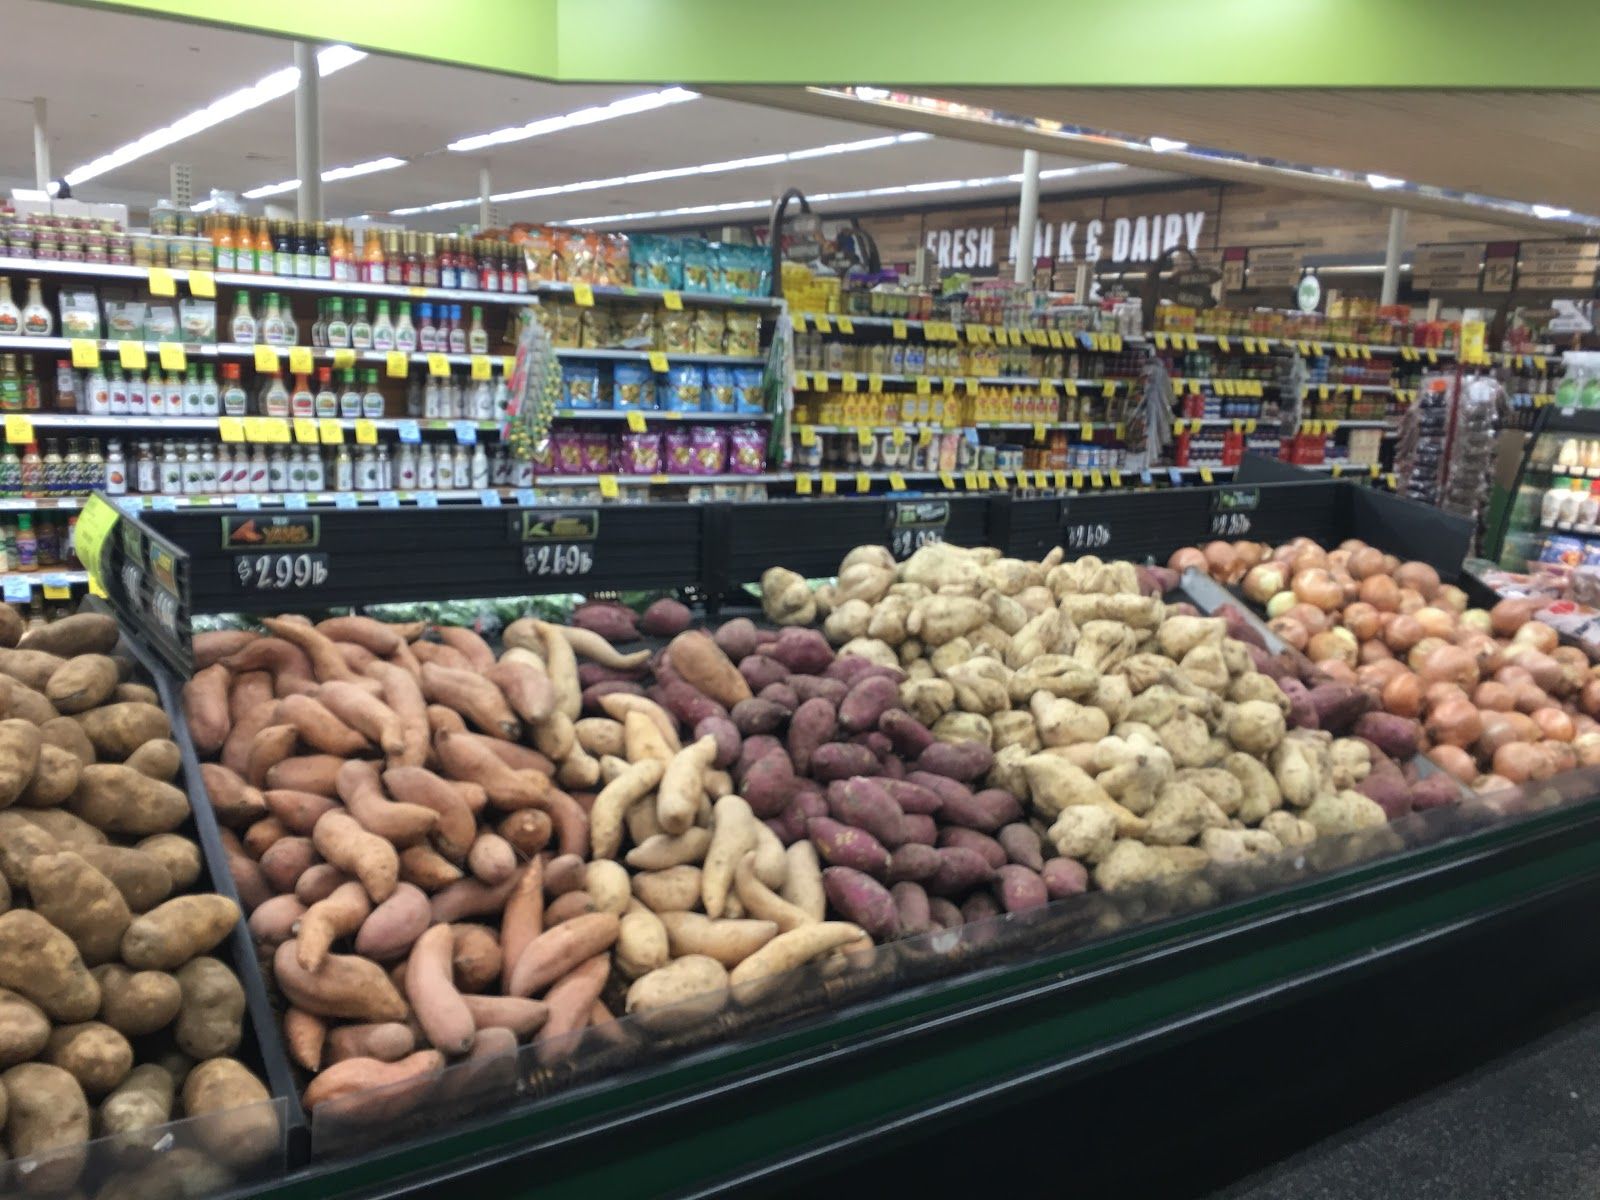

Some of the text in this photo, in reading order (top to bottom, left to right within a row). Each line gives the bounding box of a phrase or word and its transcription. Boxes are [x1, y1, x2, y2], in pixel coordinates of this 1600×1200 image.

[927, 229, 994, 268] FRESH
[1085, 218, 1103, 263] &
[1112, 211, 1206, 264] DAIRY
[1487, 263, 1510, 285] 12
